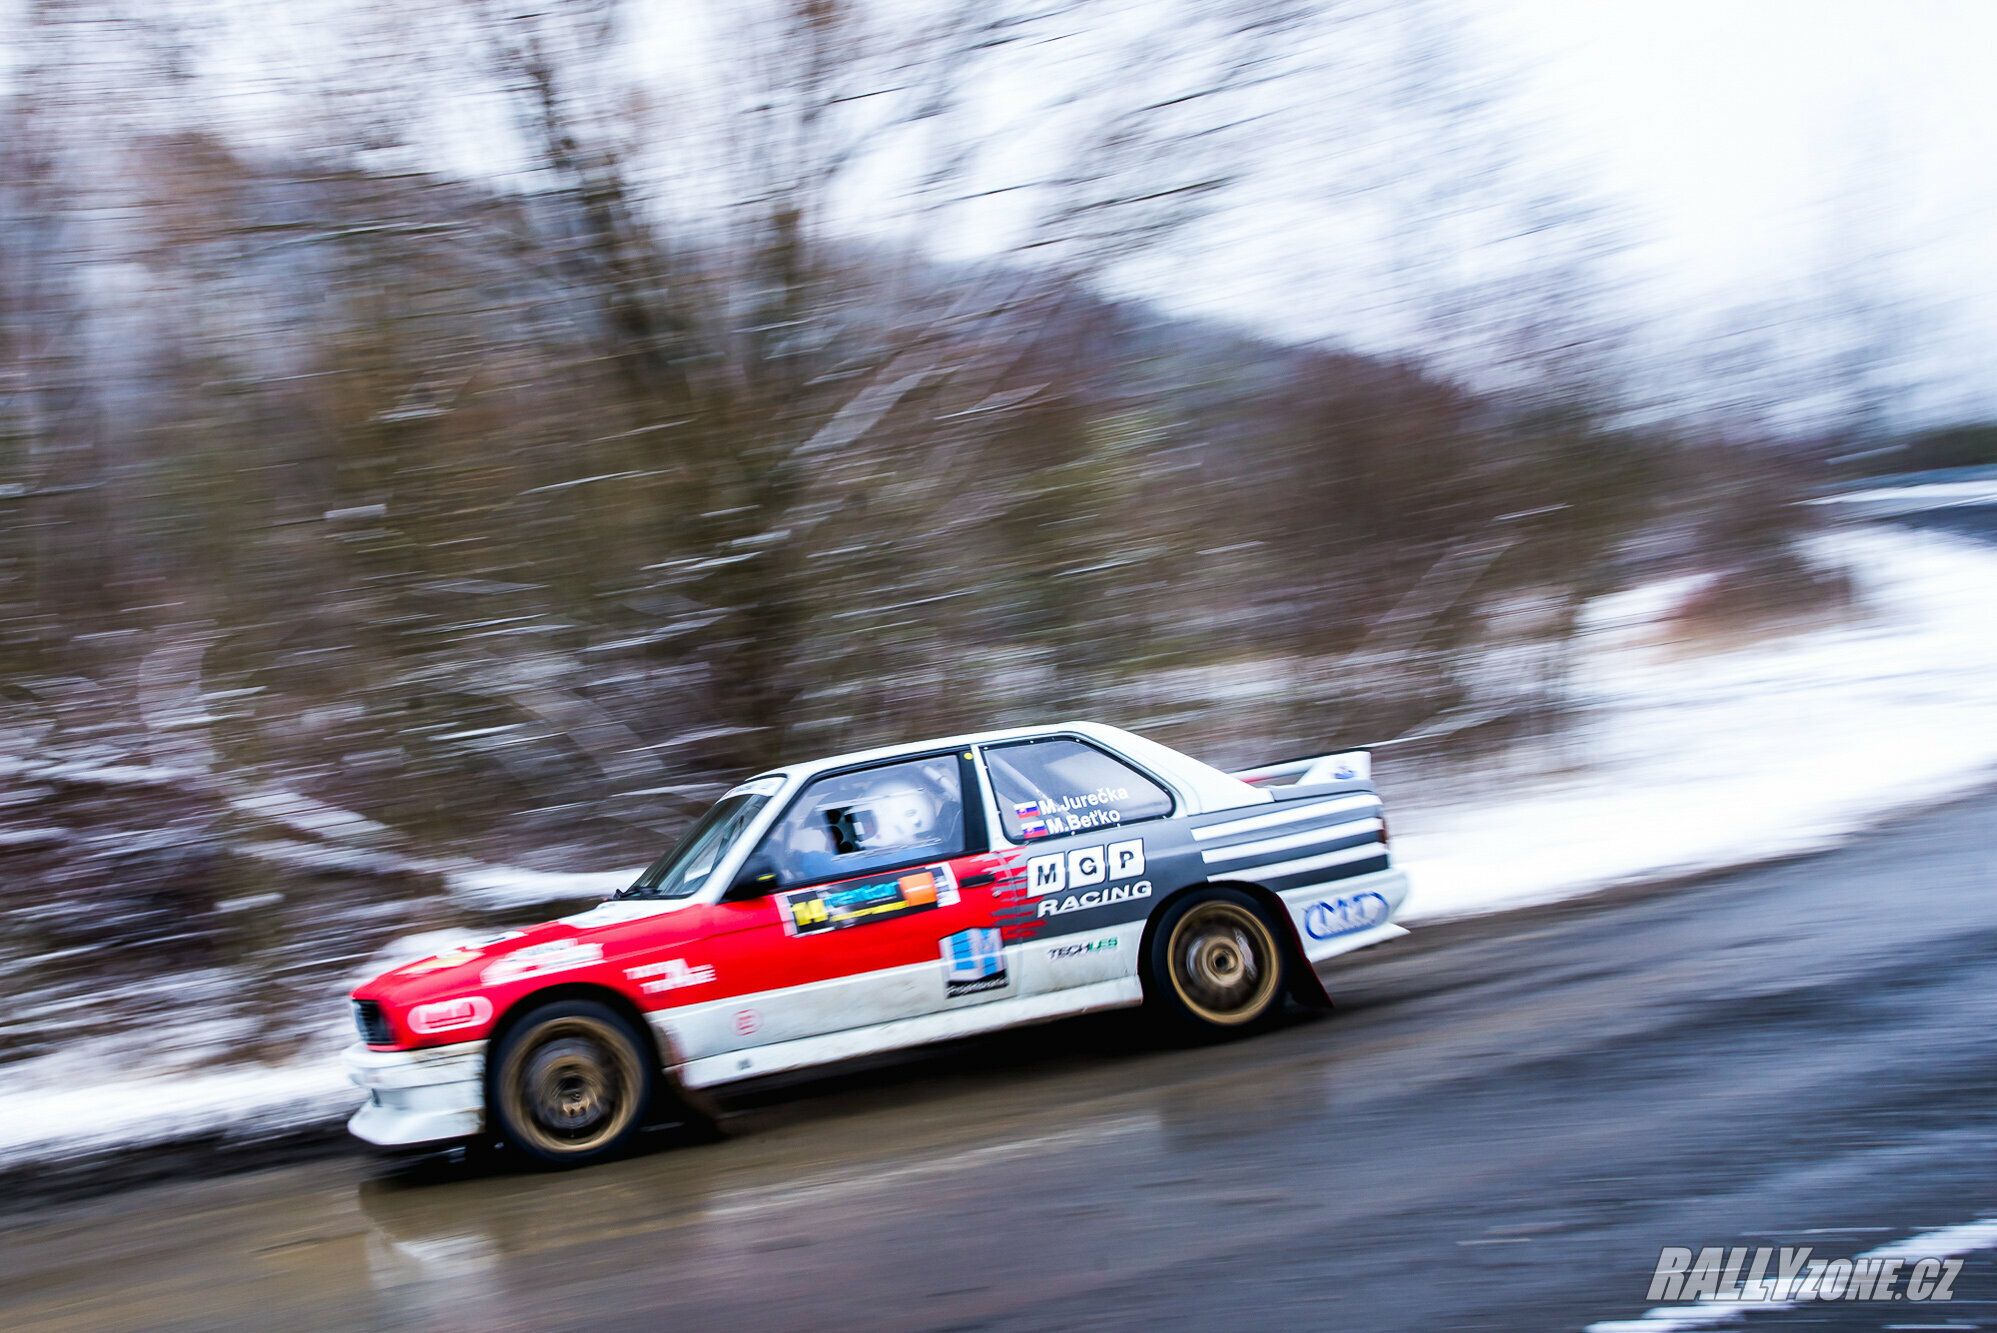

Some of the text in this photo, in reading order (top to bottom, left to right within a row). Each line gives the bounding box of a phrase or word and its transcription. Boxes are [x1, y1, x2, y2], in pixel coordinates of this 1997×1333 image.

[1038, 787, 1129, 816] M.Jurečka
[1045, 809, 1121, 835] M.Beťko
[1036, 849, 1135, 888] MGP
[1036, 880, 1153, 918] RACING
